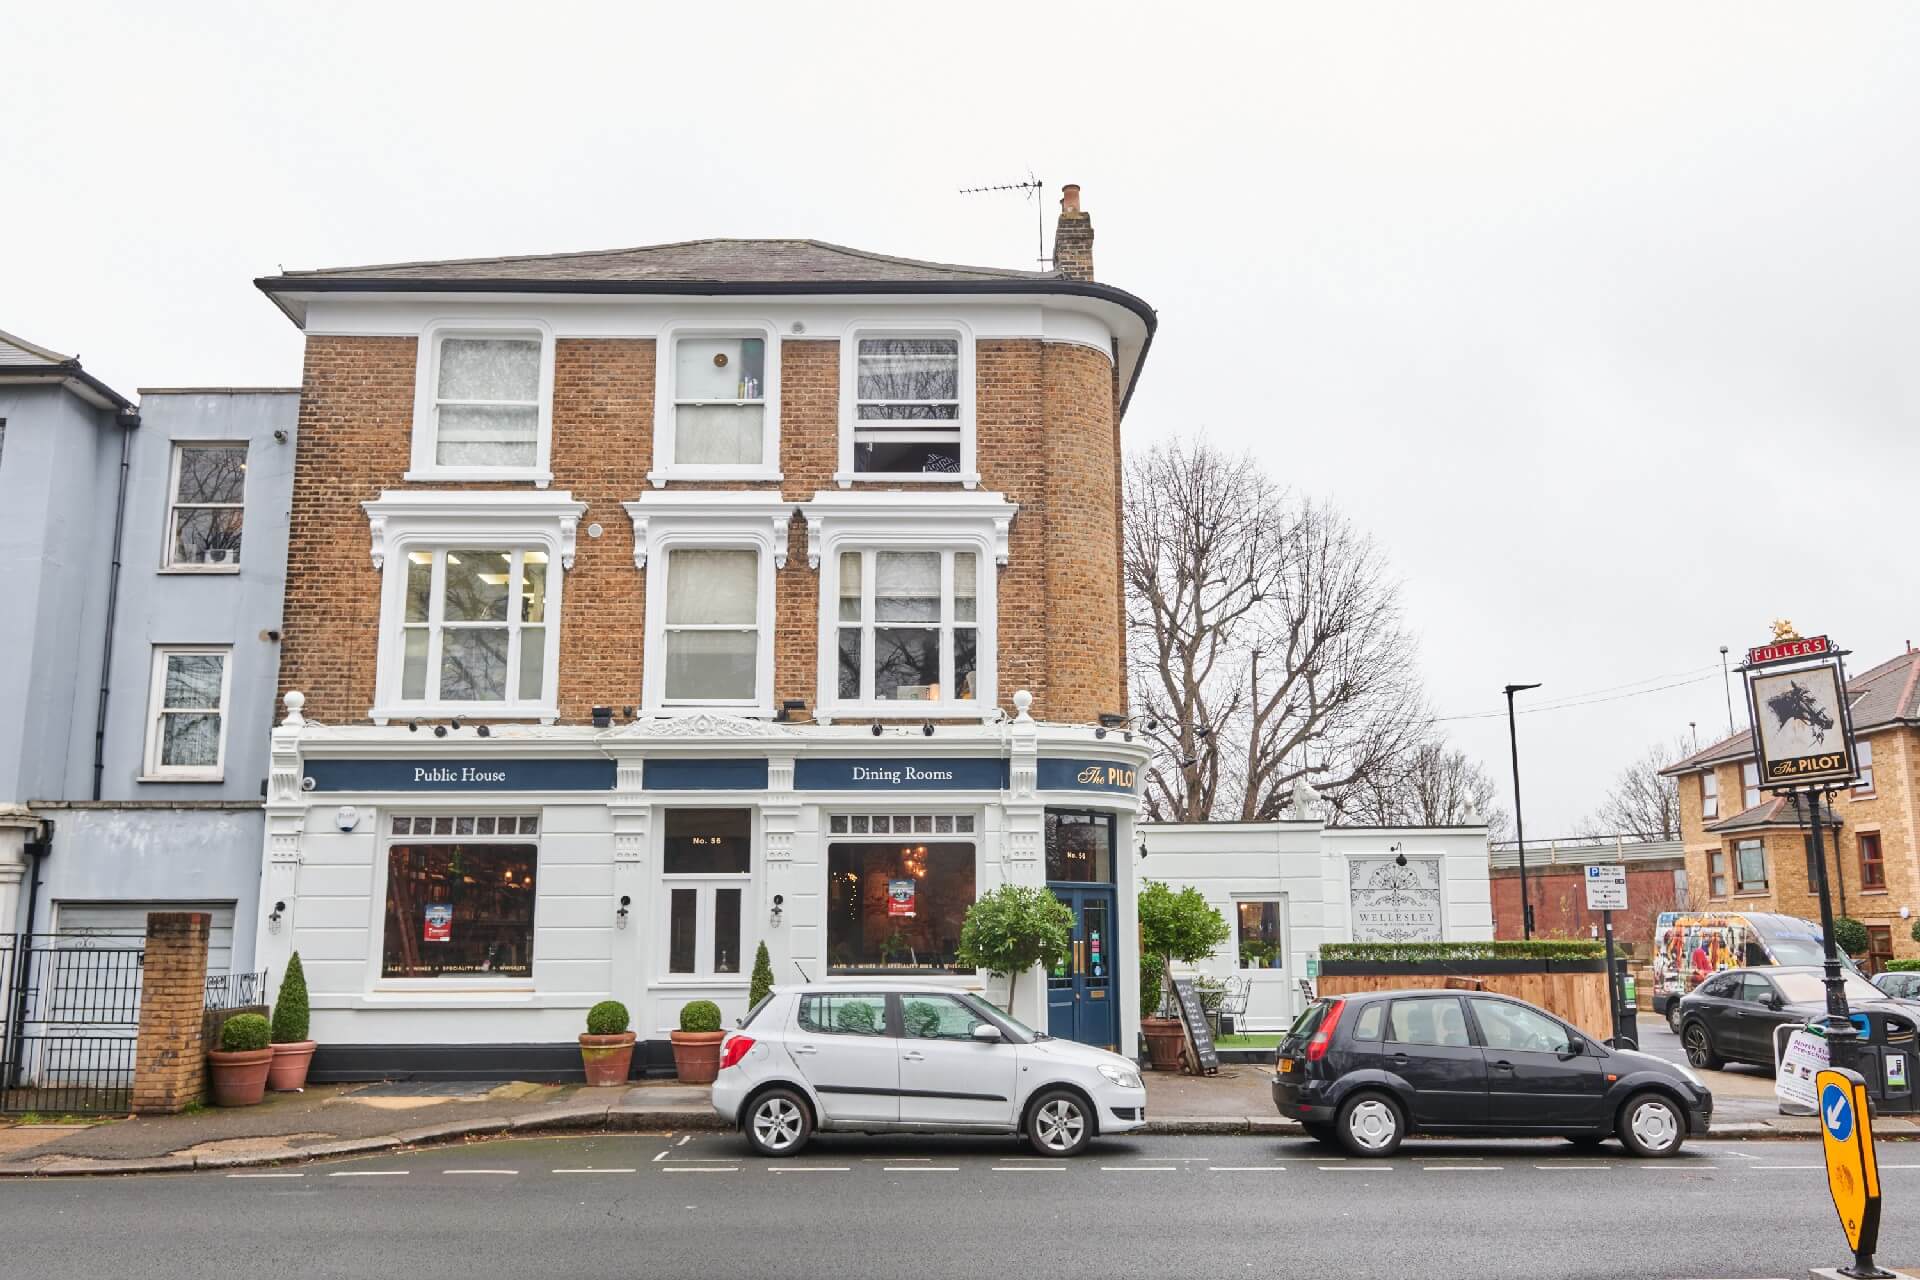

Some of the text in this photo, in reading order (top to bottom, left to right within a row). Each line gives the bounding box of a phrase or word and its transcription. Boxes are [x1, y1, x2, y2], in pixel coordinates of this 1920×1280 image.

[1754, 640, 1822, 661] FULLER'S
[1774, 755, 1841, 775] The PILOT
[414, 767, 506, 782] Public House
[852, 766, 953, 784] Dining Rooms
[1077, 766, 1105, 785] The
[692, 837, 708, 845] No.
[1359, 913, 1434, 921] WELLESLEY
